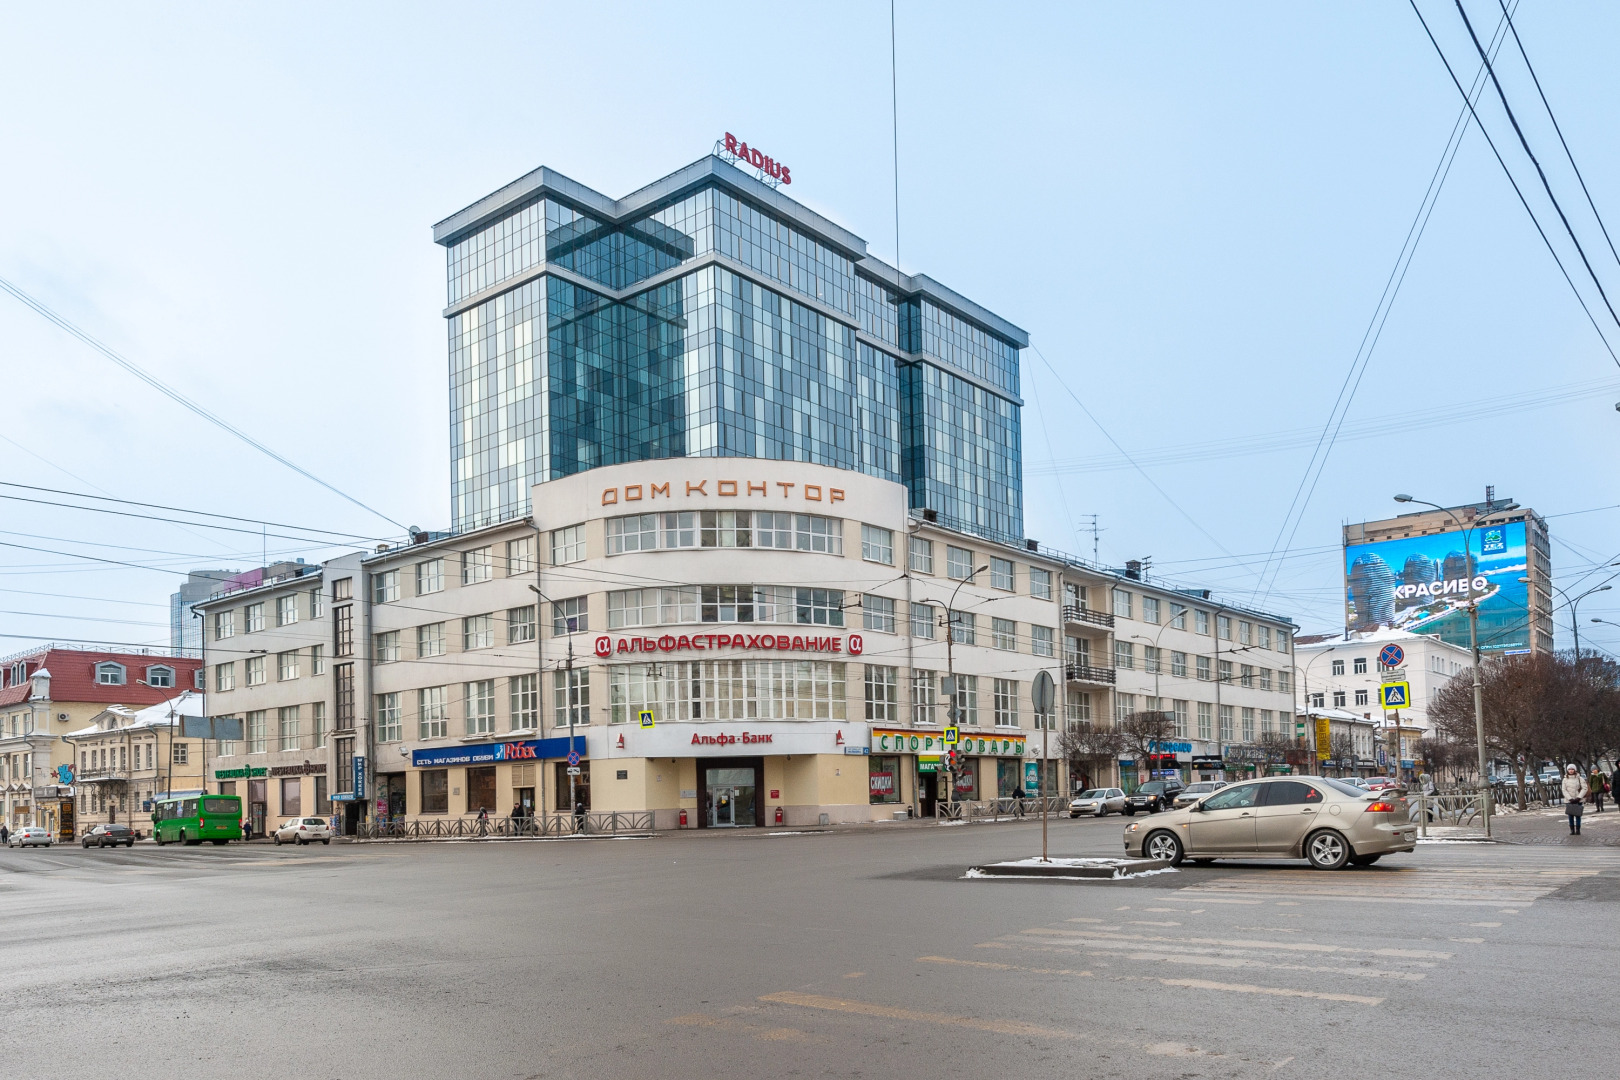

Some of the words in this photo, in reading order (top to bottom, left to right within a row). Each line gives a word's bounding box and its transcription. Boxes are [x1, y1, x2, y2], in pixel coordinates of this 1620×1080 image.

[725, 131, 791, 185] RADIUS
[602, 481, 670, 506] ДОМ
[686, 479, 846, 504] КОНТОР
[1395, 576, 1488, 600] КРАСИВО
[617, 634, 842, 653] АЛЬФАСТРАХОВАНИЕ
[880, 734, 1025, 754] СПОРТОВАРЫ
[434, 756, 470, 764] МАГАЗИНОВ
[472, 754, 494, 762] ОБУВИ
[870, 775, 892, 791] СКИДКИ
